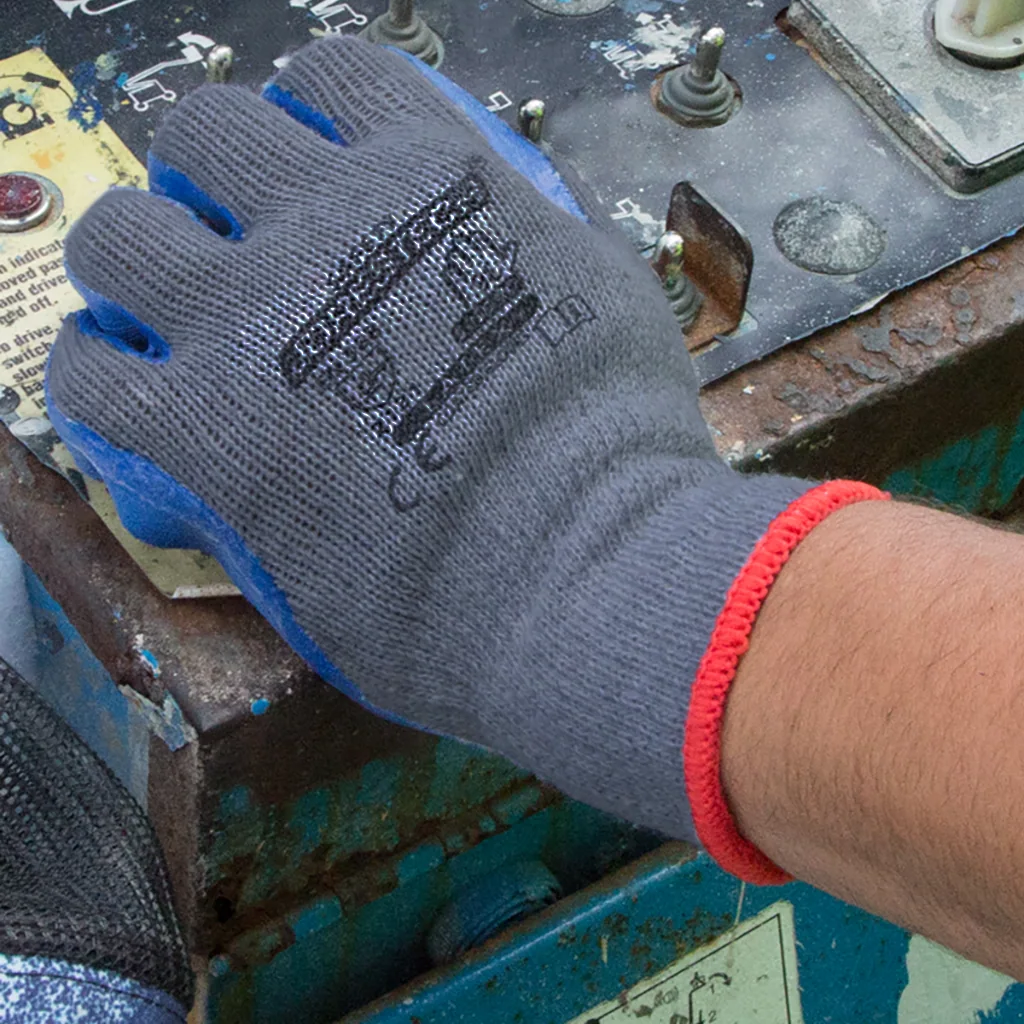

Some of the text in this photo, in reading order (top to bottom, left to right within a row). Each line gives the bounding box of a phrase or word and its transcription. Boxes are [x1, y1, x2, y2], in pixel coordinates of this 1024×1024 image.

[8, 240, 65, 268] indicat
[0, 267, 37, 292] oved
[12, 358, 48, 382] slow
